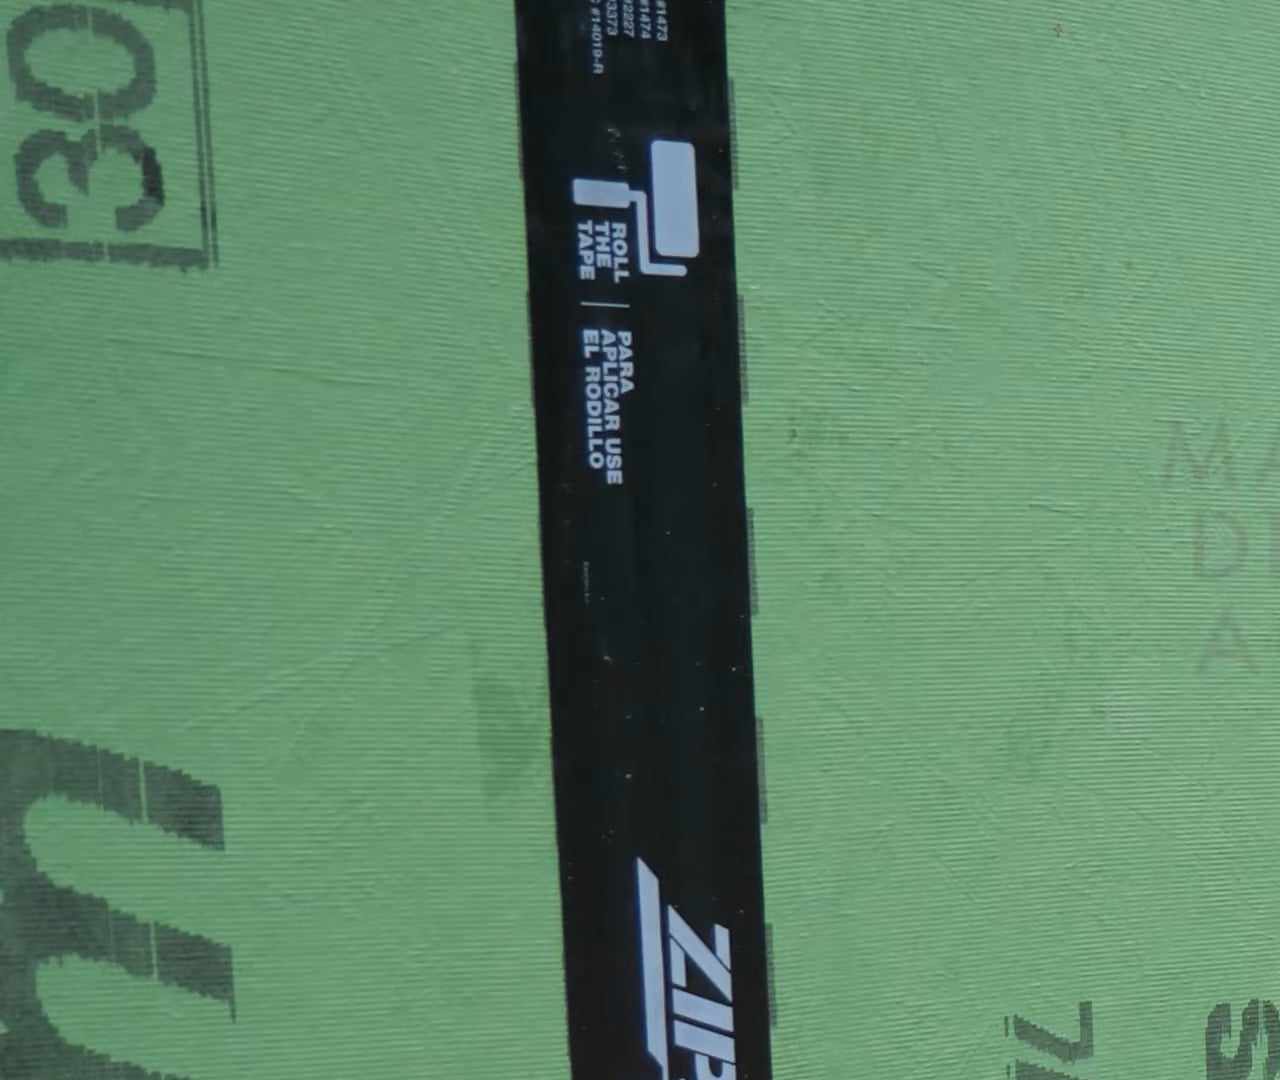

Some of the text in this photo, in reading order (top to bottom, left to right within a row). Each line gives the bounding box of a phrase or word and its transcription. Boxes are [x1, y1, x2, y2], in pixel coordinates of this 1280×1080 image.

[5, 0, 165, 233] 30
[577, 219, 596, 281] TAPE
[594, 220, 612, 268] THE
[611, 220, 630, 284] ROLL
[617, 330, 635, 394] PARA
[582, 328, 606, 470] EL RODILLO
[601, 328, 624, 485] APLICAR USE
